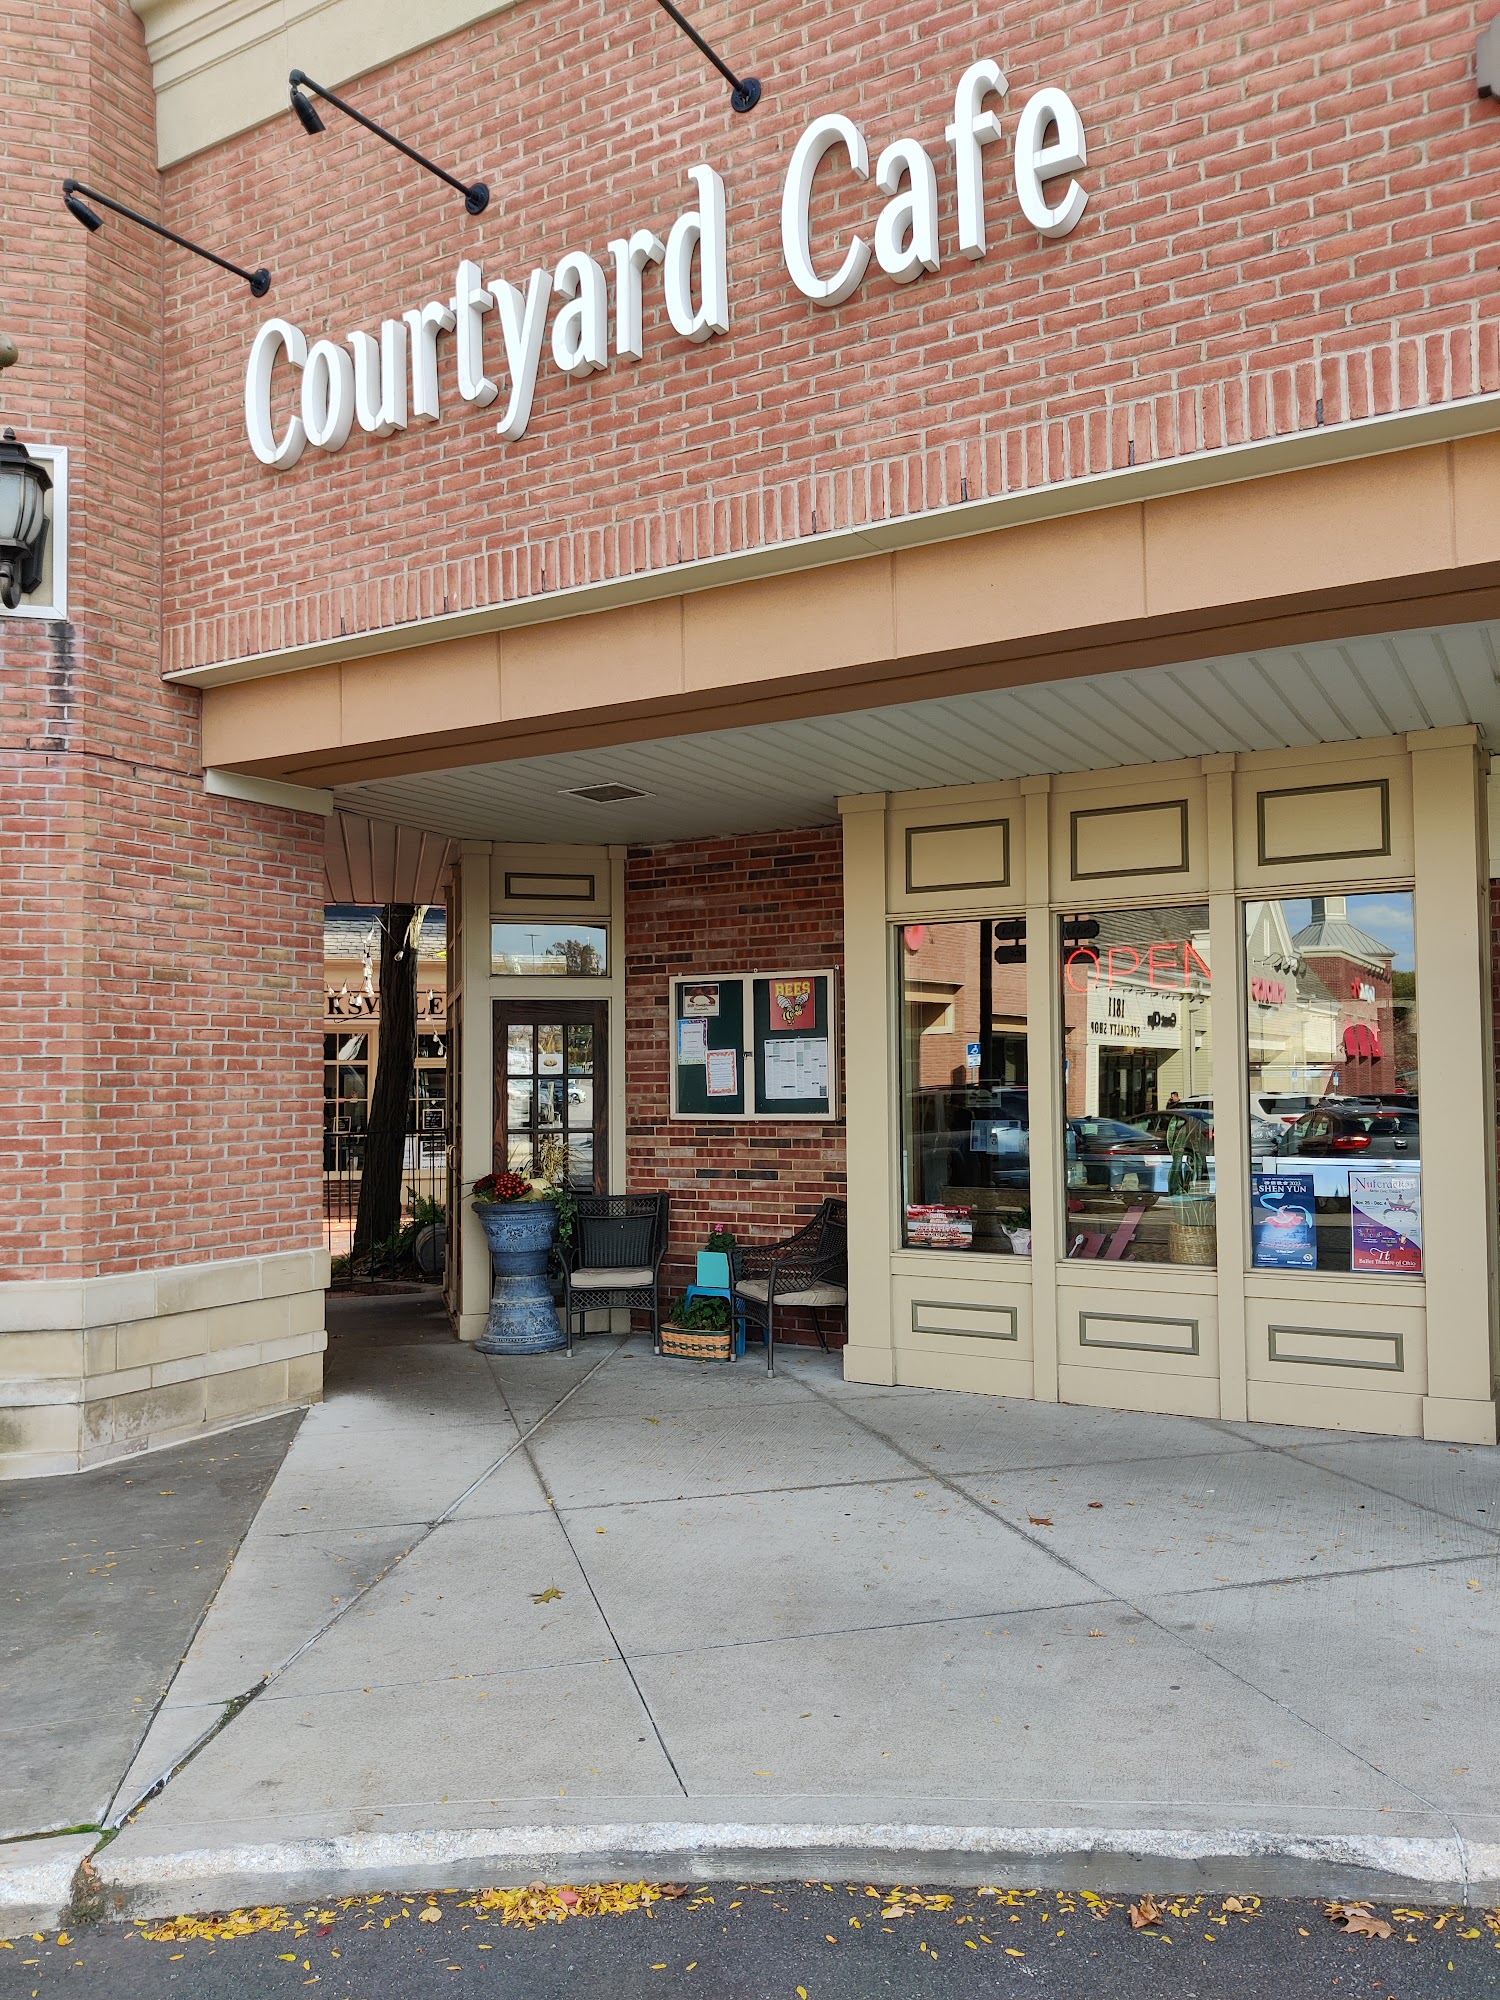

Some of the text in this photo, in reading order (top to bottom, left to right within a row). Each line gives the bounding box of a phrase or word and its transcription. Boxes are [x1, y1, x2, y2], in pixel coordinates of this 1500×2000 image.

[242, 57, 1091, 472] Courtyard Cafe
[1066, 940, 1213, 992] OPEN
[775, 981, 810, 998] BEES
[1258, 1185, 1307, 1194] SHEN YUN
